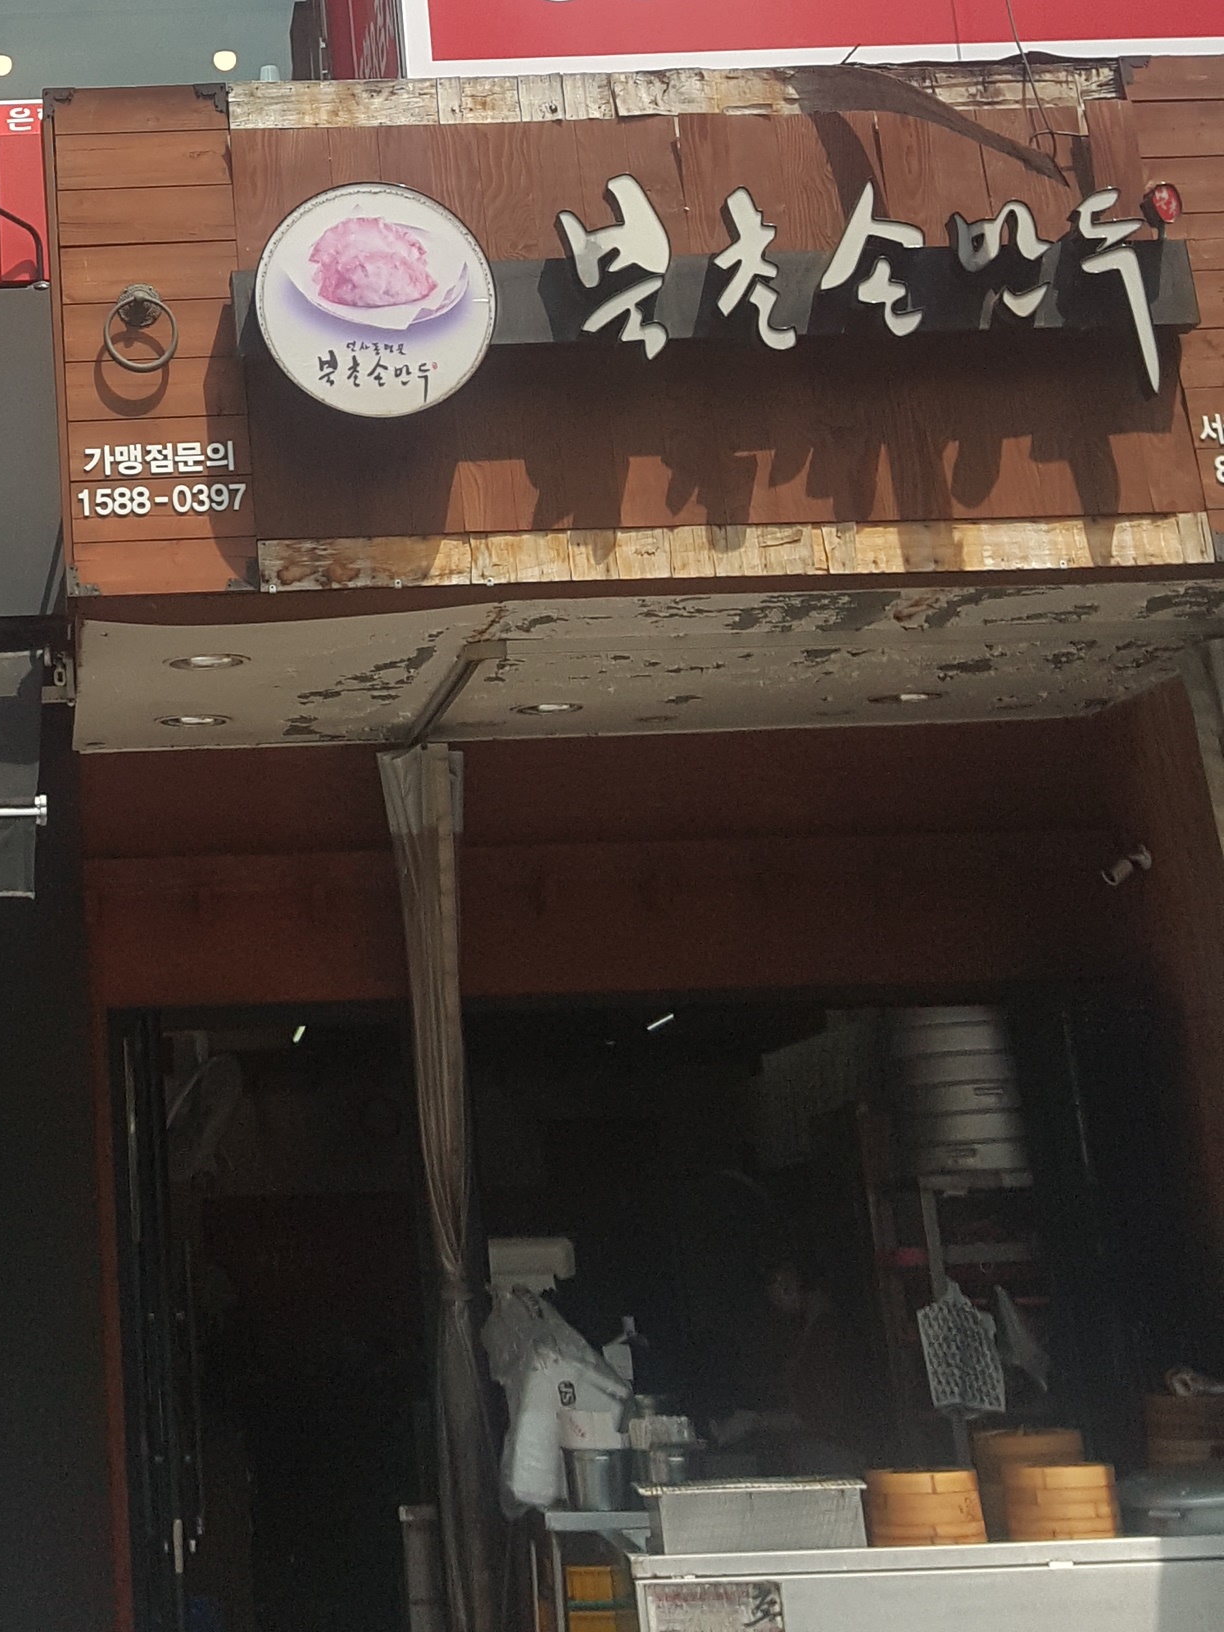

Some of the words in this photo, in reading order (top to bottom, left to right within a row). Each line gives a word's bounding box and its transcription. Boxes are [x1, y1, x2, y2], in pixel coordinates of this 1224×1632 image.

[7, 106, 43, 132] 은
[83, 440, 235, 476] 가맹점문의
[77, 482, 247, 518] 1588-0397
